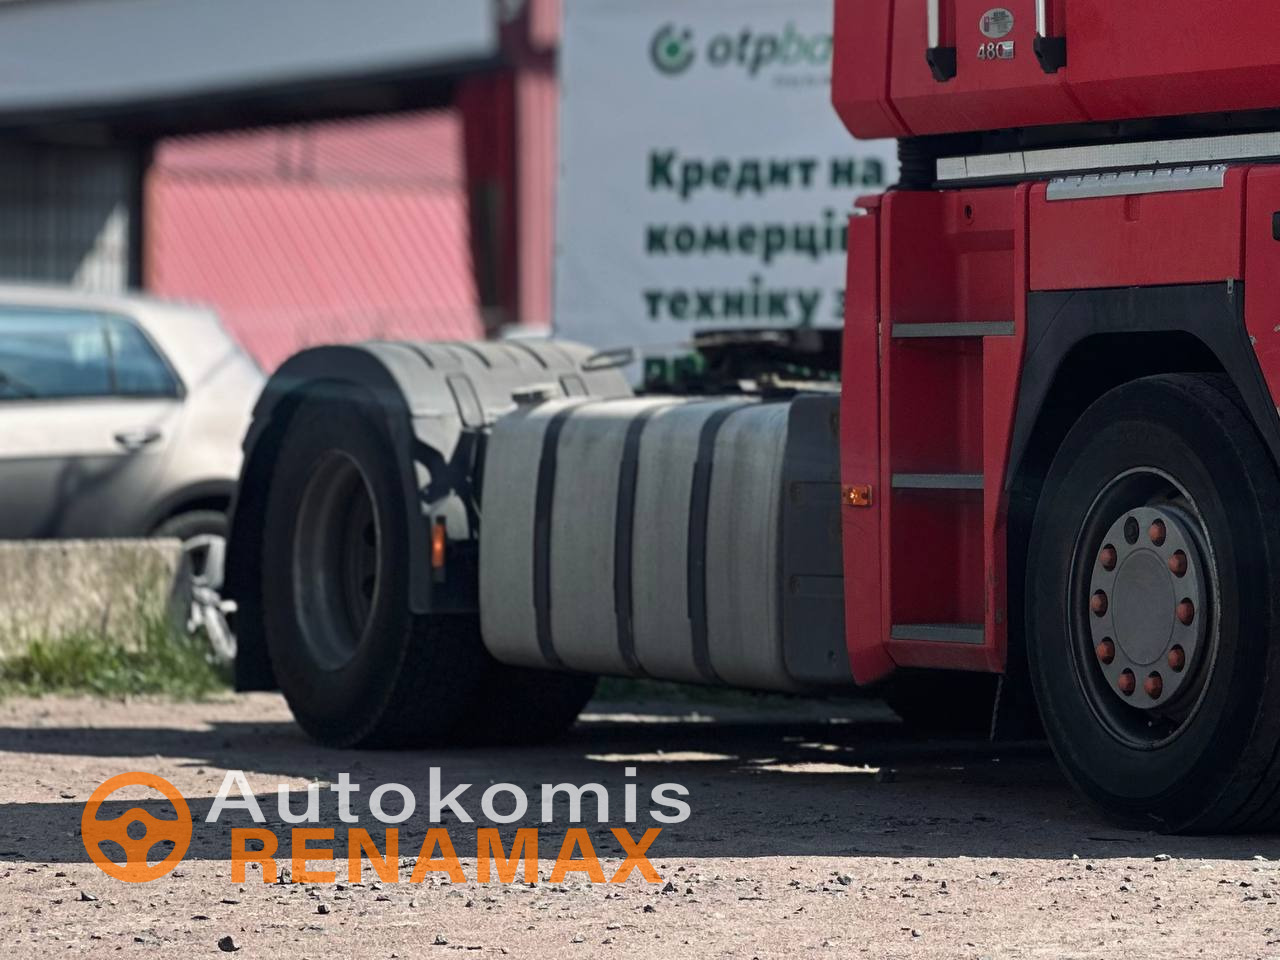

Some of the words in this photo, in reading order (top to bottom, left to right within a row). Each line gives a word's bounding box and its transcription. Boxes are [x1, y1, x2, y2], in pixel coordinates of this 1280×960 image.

[707, 20, 833, 77] otpba
[649, 151, 818, 199] Кредит
[830, 160, 885, 188] на
[643, 274, 820, 327] техніку
